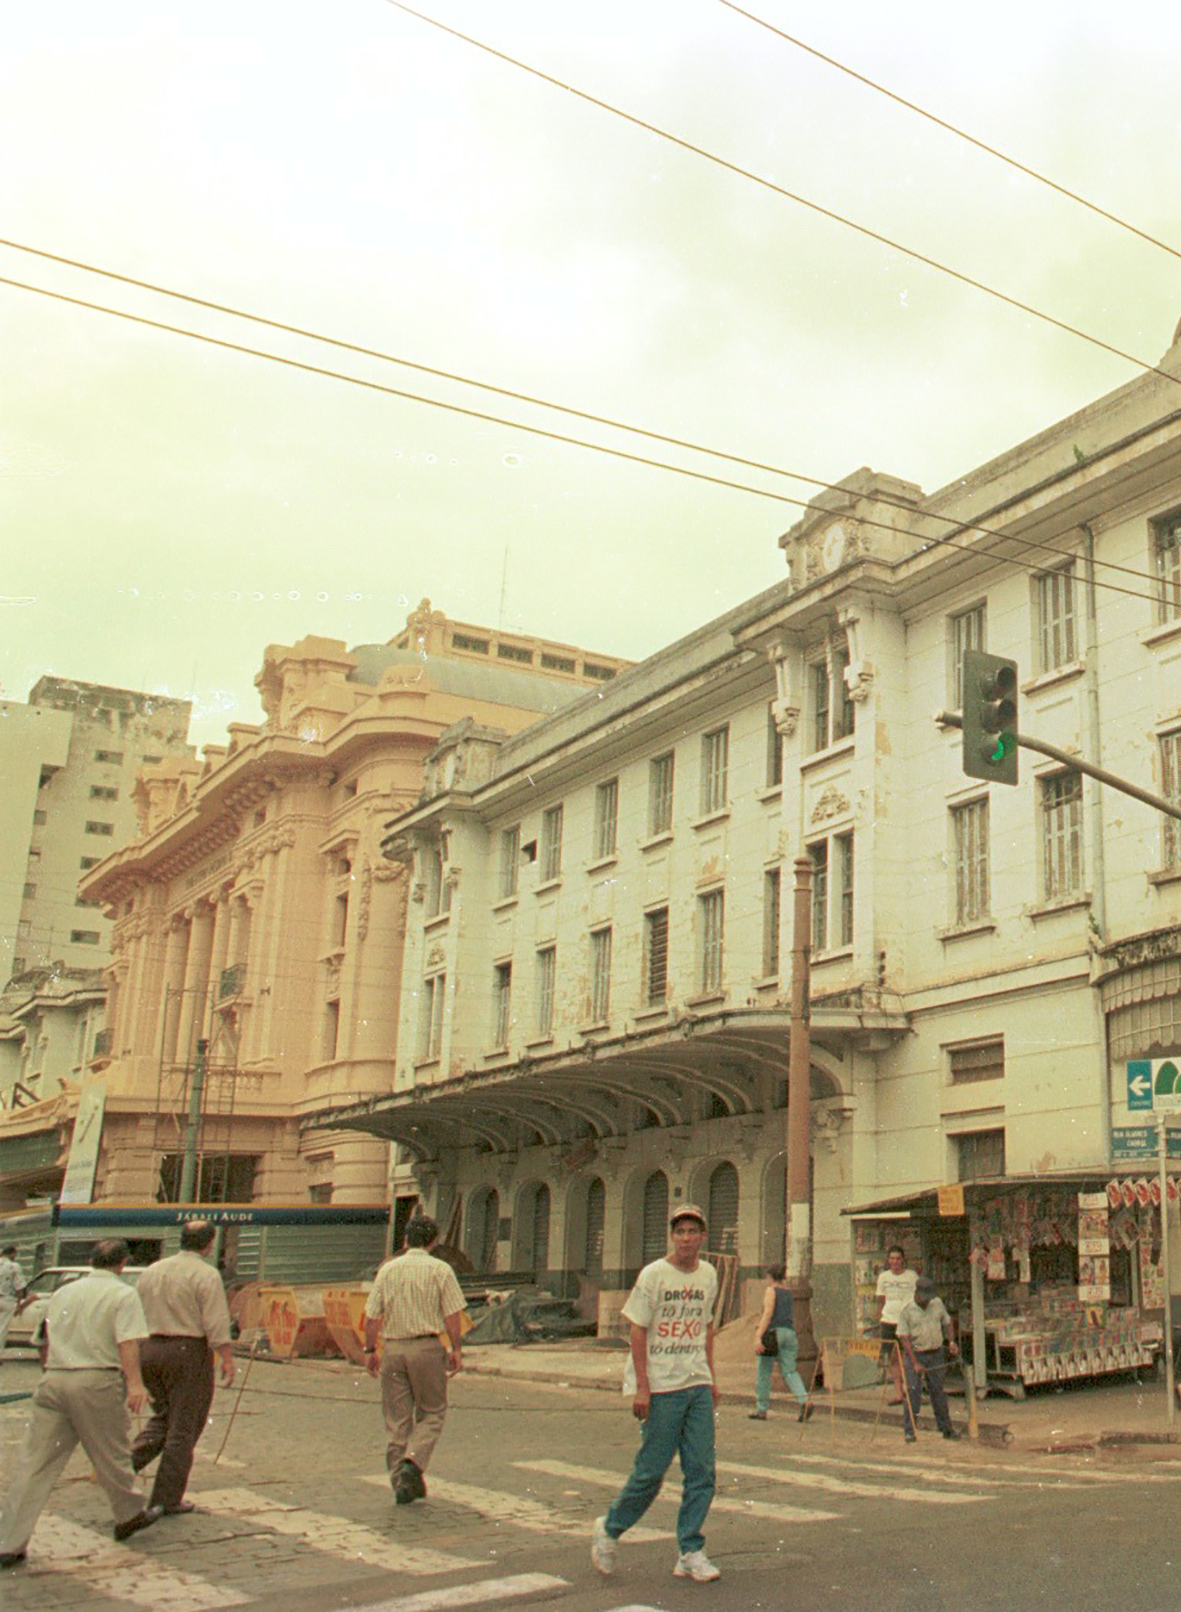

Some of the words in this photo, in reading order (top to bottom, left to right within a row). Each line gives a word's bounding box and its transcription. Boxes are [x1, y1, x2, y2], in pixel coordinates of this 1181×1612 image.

[221, 1211, 253, 1221] AUDE
[664, 1289, 704, 1301] DROGAS
[678, 1302, 703, 1320] fora
[657, 1319, 700, 1340] SEXO
